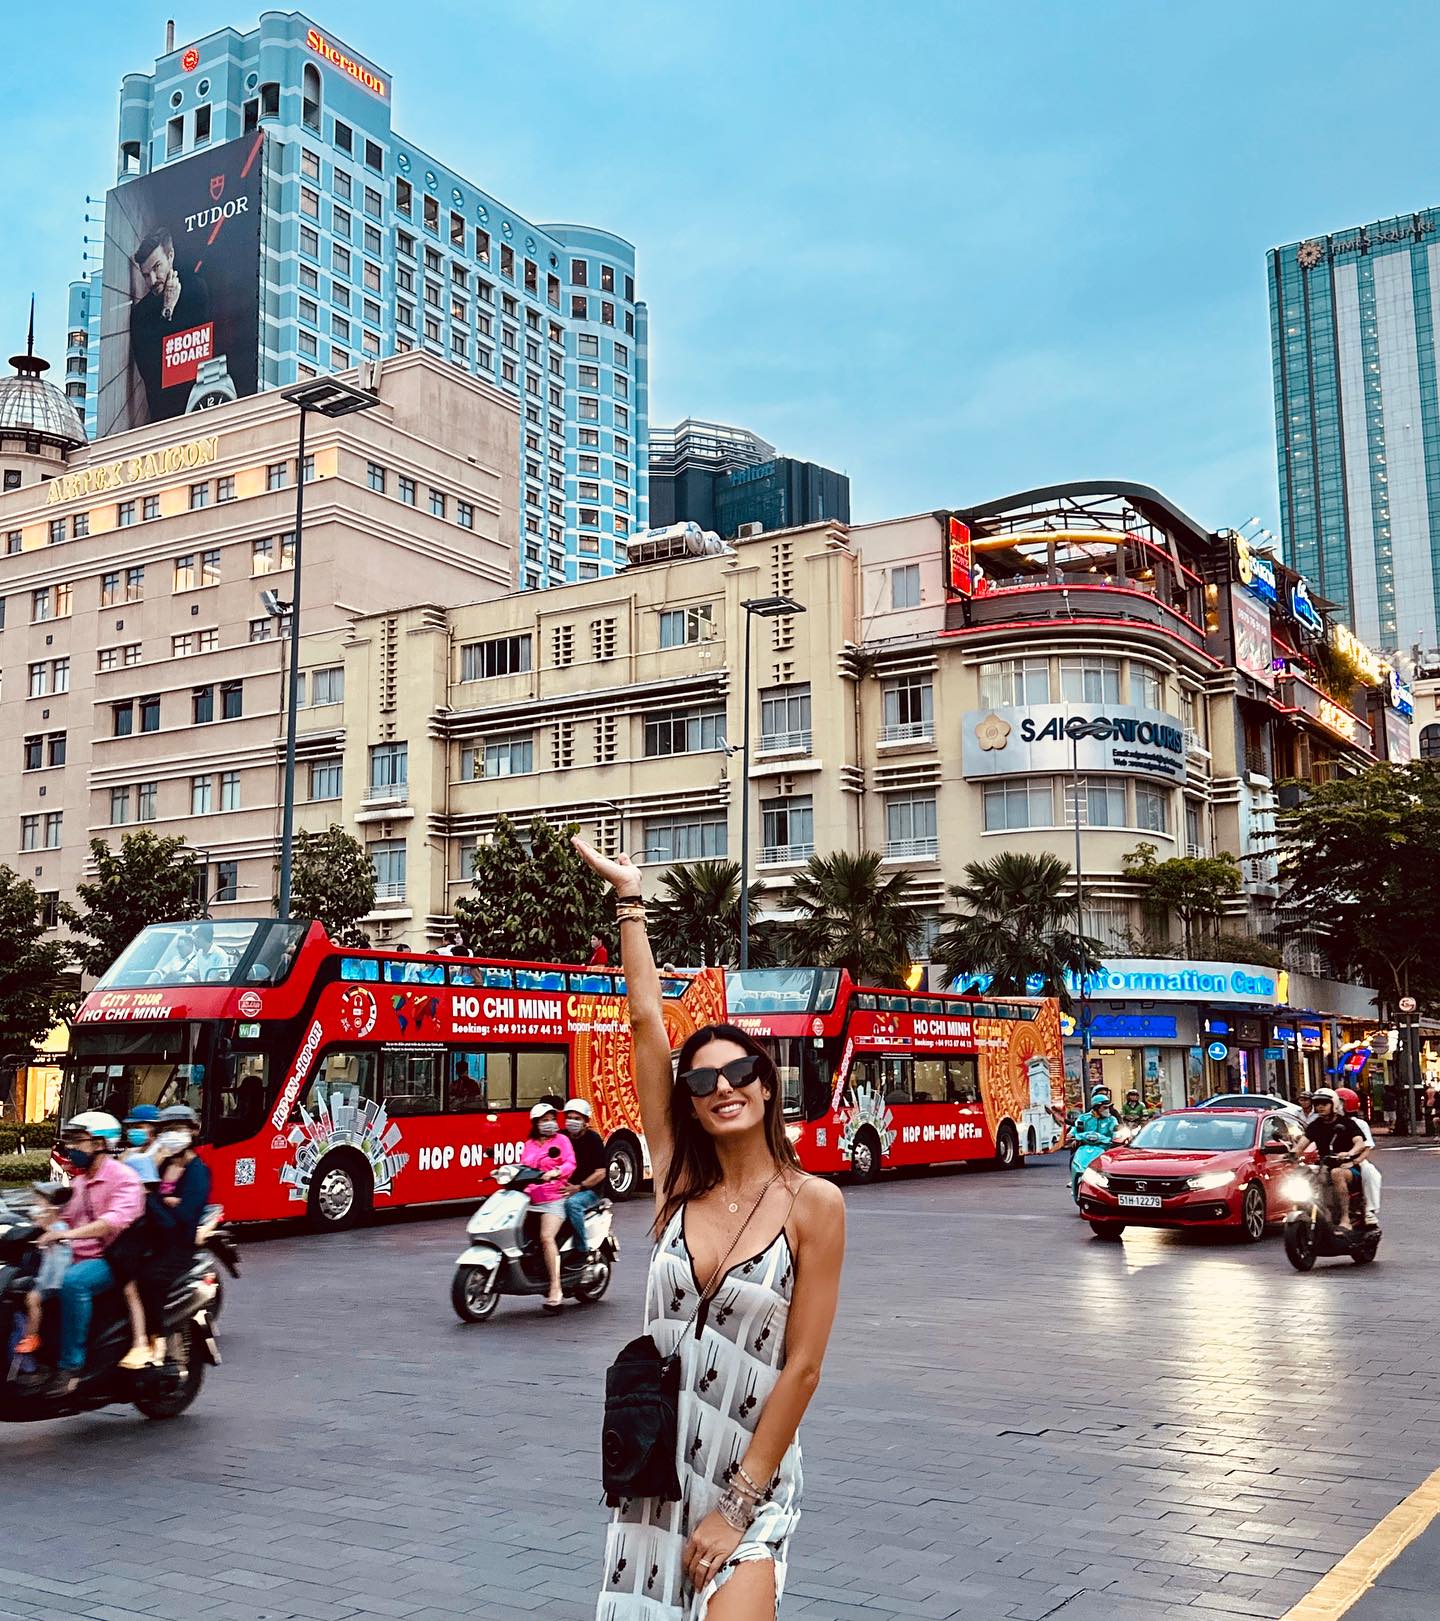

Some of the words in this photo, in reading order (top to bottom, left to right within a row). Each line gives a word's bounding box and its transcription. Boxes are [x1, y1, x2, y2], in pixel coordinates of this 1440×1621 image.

[306, 28, 385, 96] Sheraton
[184, 195, 249, 232] TUDOR
[1330, 236, 1371, 255] TIMES
[1376, 220, 1437, 244] SQUARE
[165, 327, 210, 354] #BORN
[207, 397, 215, 407] 12
[46, 461, 123, 504] ARTEX
[126, 435, 219, 483] SAIGON
[83, 1009, 103, 1022] HO
[104, 1008, 129, 1020] CHI
[131, 1007, 172, 1019] MINH
[452, 996, 480, 1018] HO
[483, 997, 514, 1019] CHI
[518, 998, 562, 1020] MINH
[452, 1023, 490, 1036] Booking:
[493, 1024, 509, 1034] +84
[511, 1024, 527, 1034] 913
[528, 1025, 539, 1034] 67
[540, 1025, 550, 1034] 44
[553, 1025, 562, 1035] 12
[914, 1019, 929, 1035] HO
[929, 1020, 946, 1036] CHI
[948, 1021, 971, 1037] MINH
[903, 1126, 921, 1143] HOP
[419, 1146, 454, 1171] HOP
